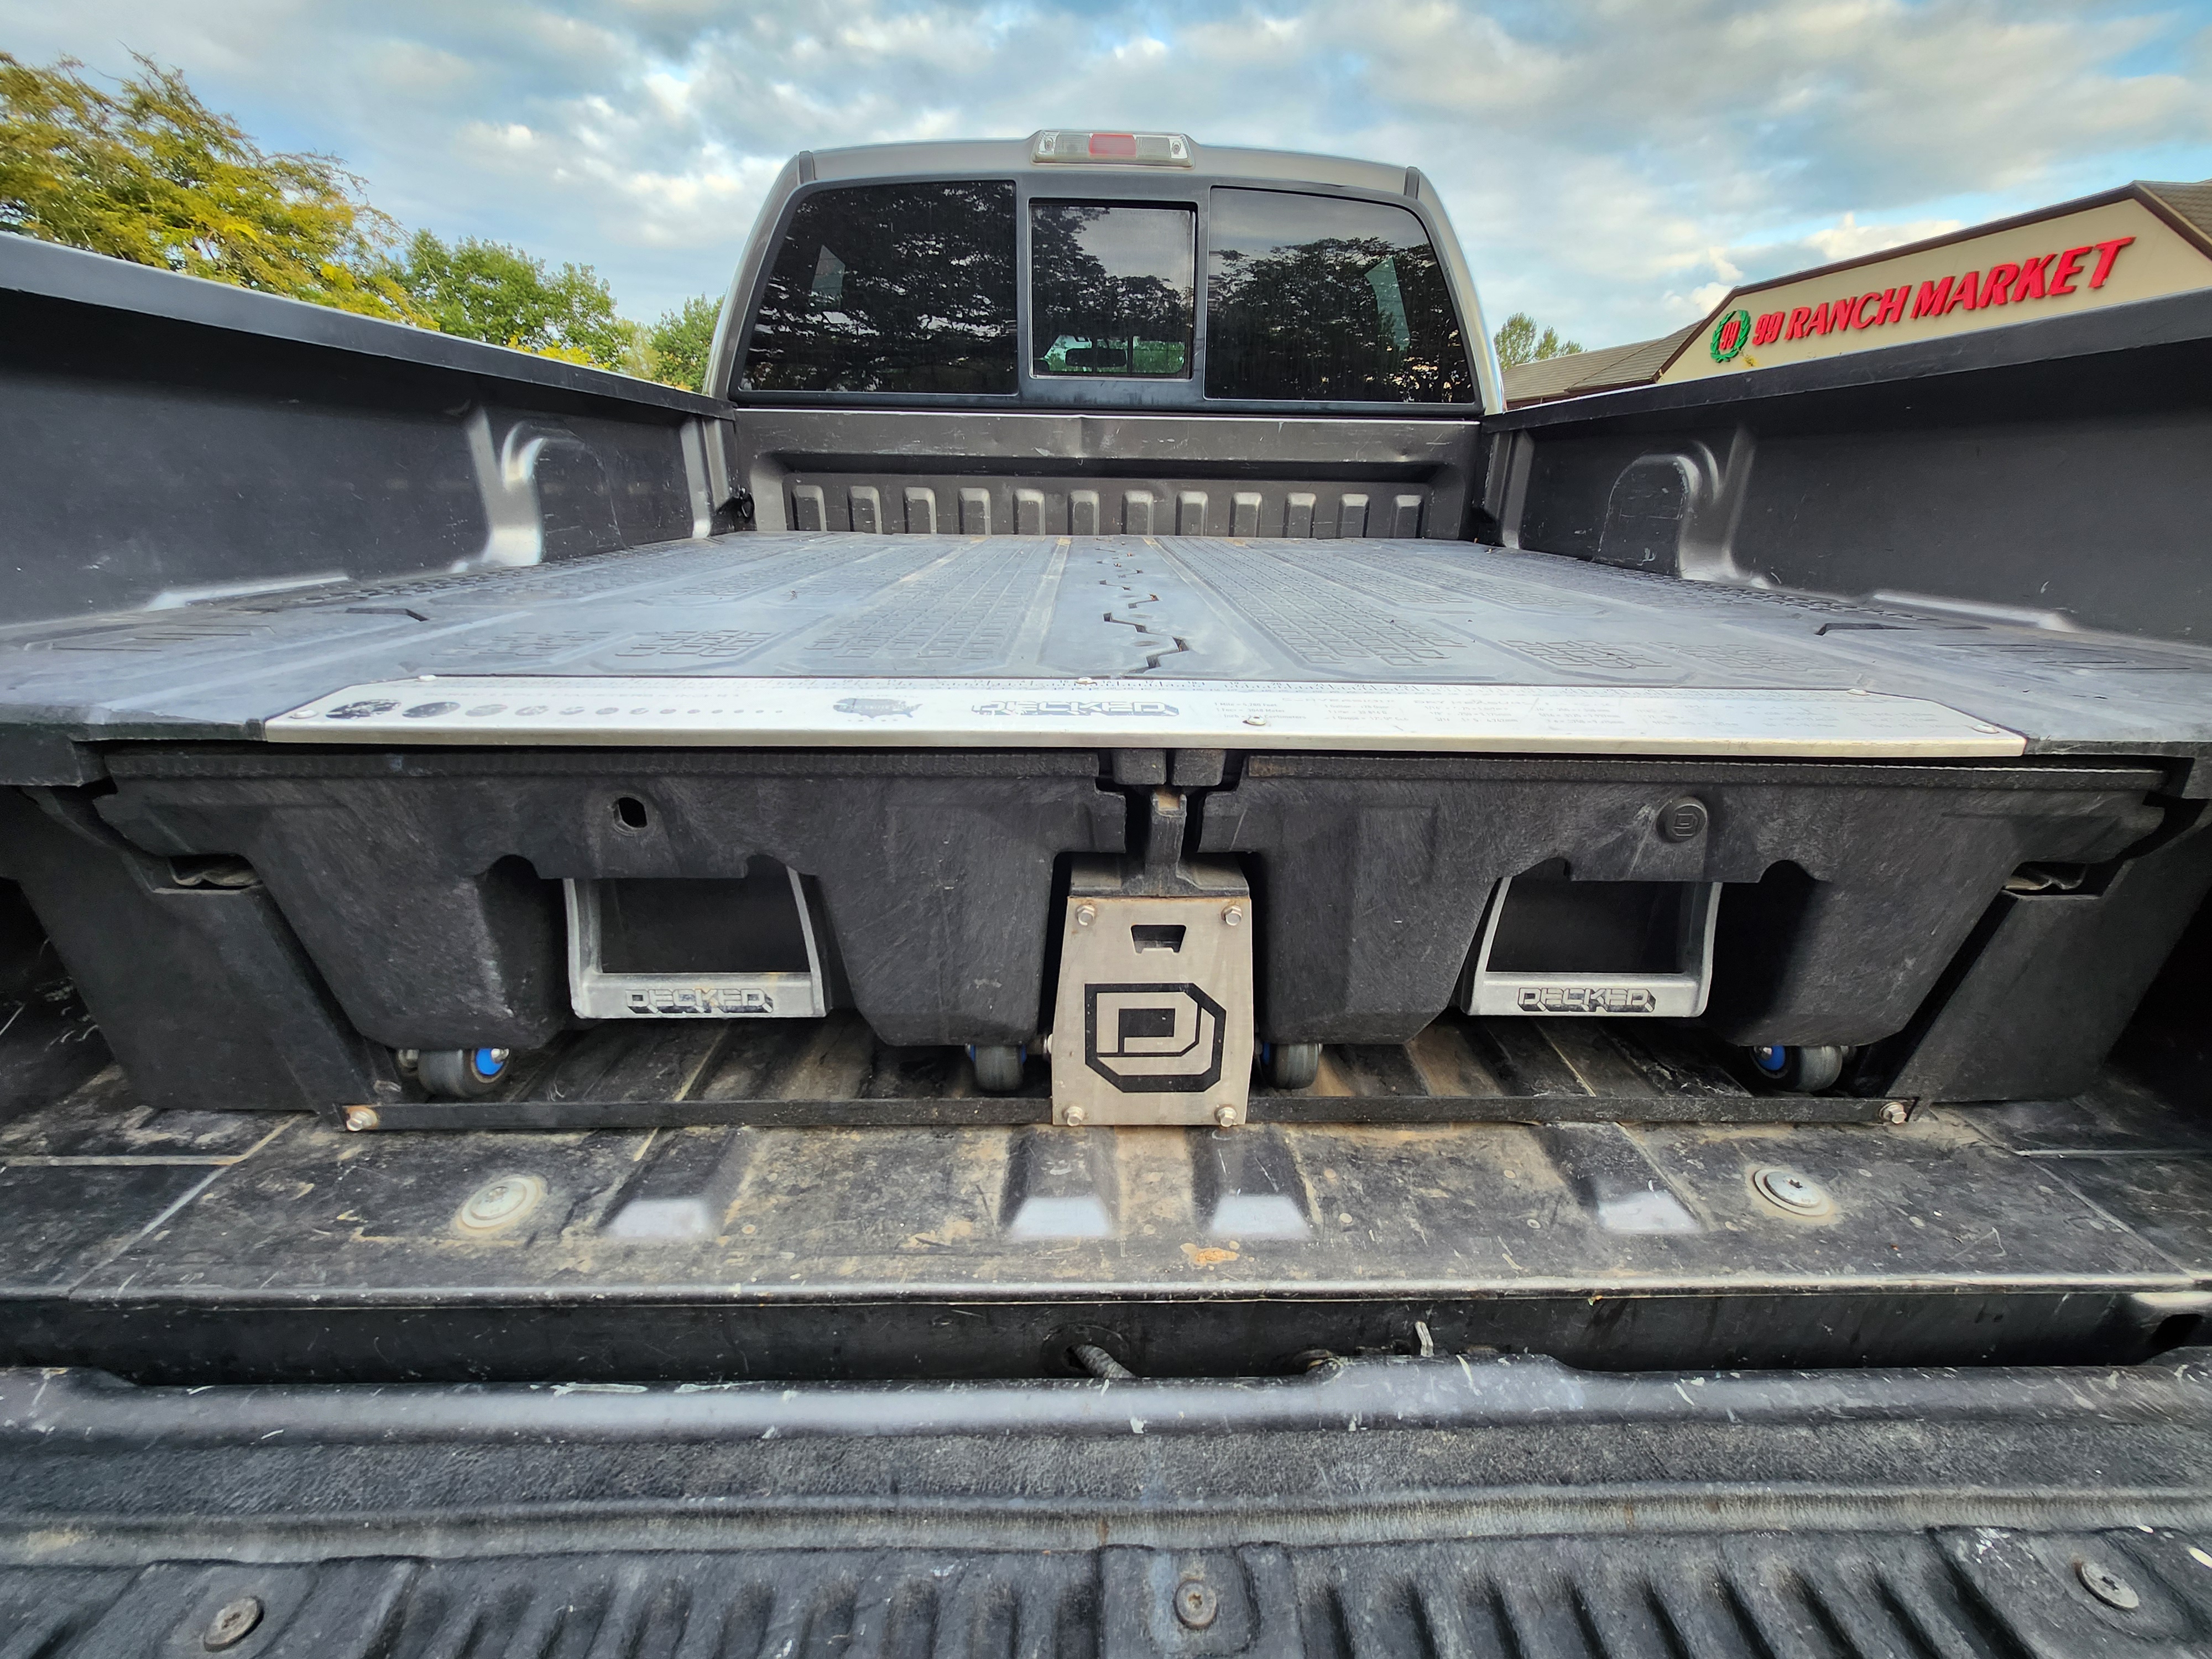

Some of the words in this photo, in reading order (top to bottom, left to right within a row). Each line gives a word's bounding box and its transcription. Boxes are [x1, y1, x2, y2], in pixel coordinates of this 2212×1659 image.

[1752, 311, 1786, 346] 99
[1784, 285, 1912, 341] RANCH
[1910, 237, 2136, 319] MARKET
[1719, 321, 1740, 350] 99
[972, 701, 1179, 716] DECKED
[625, 988, 774, 1014] DECKED
[1518, 988, 1656, 1013] DECKED
